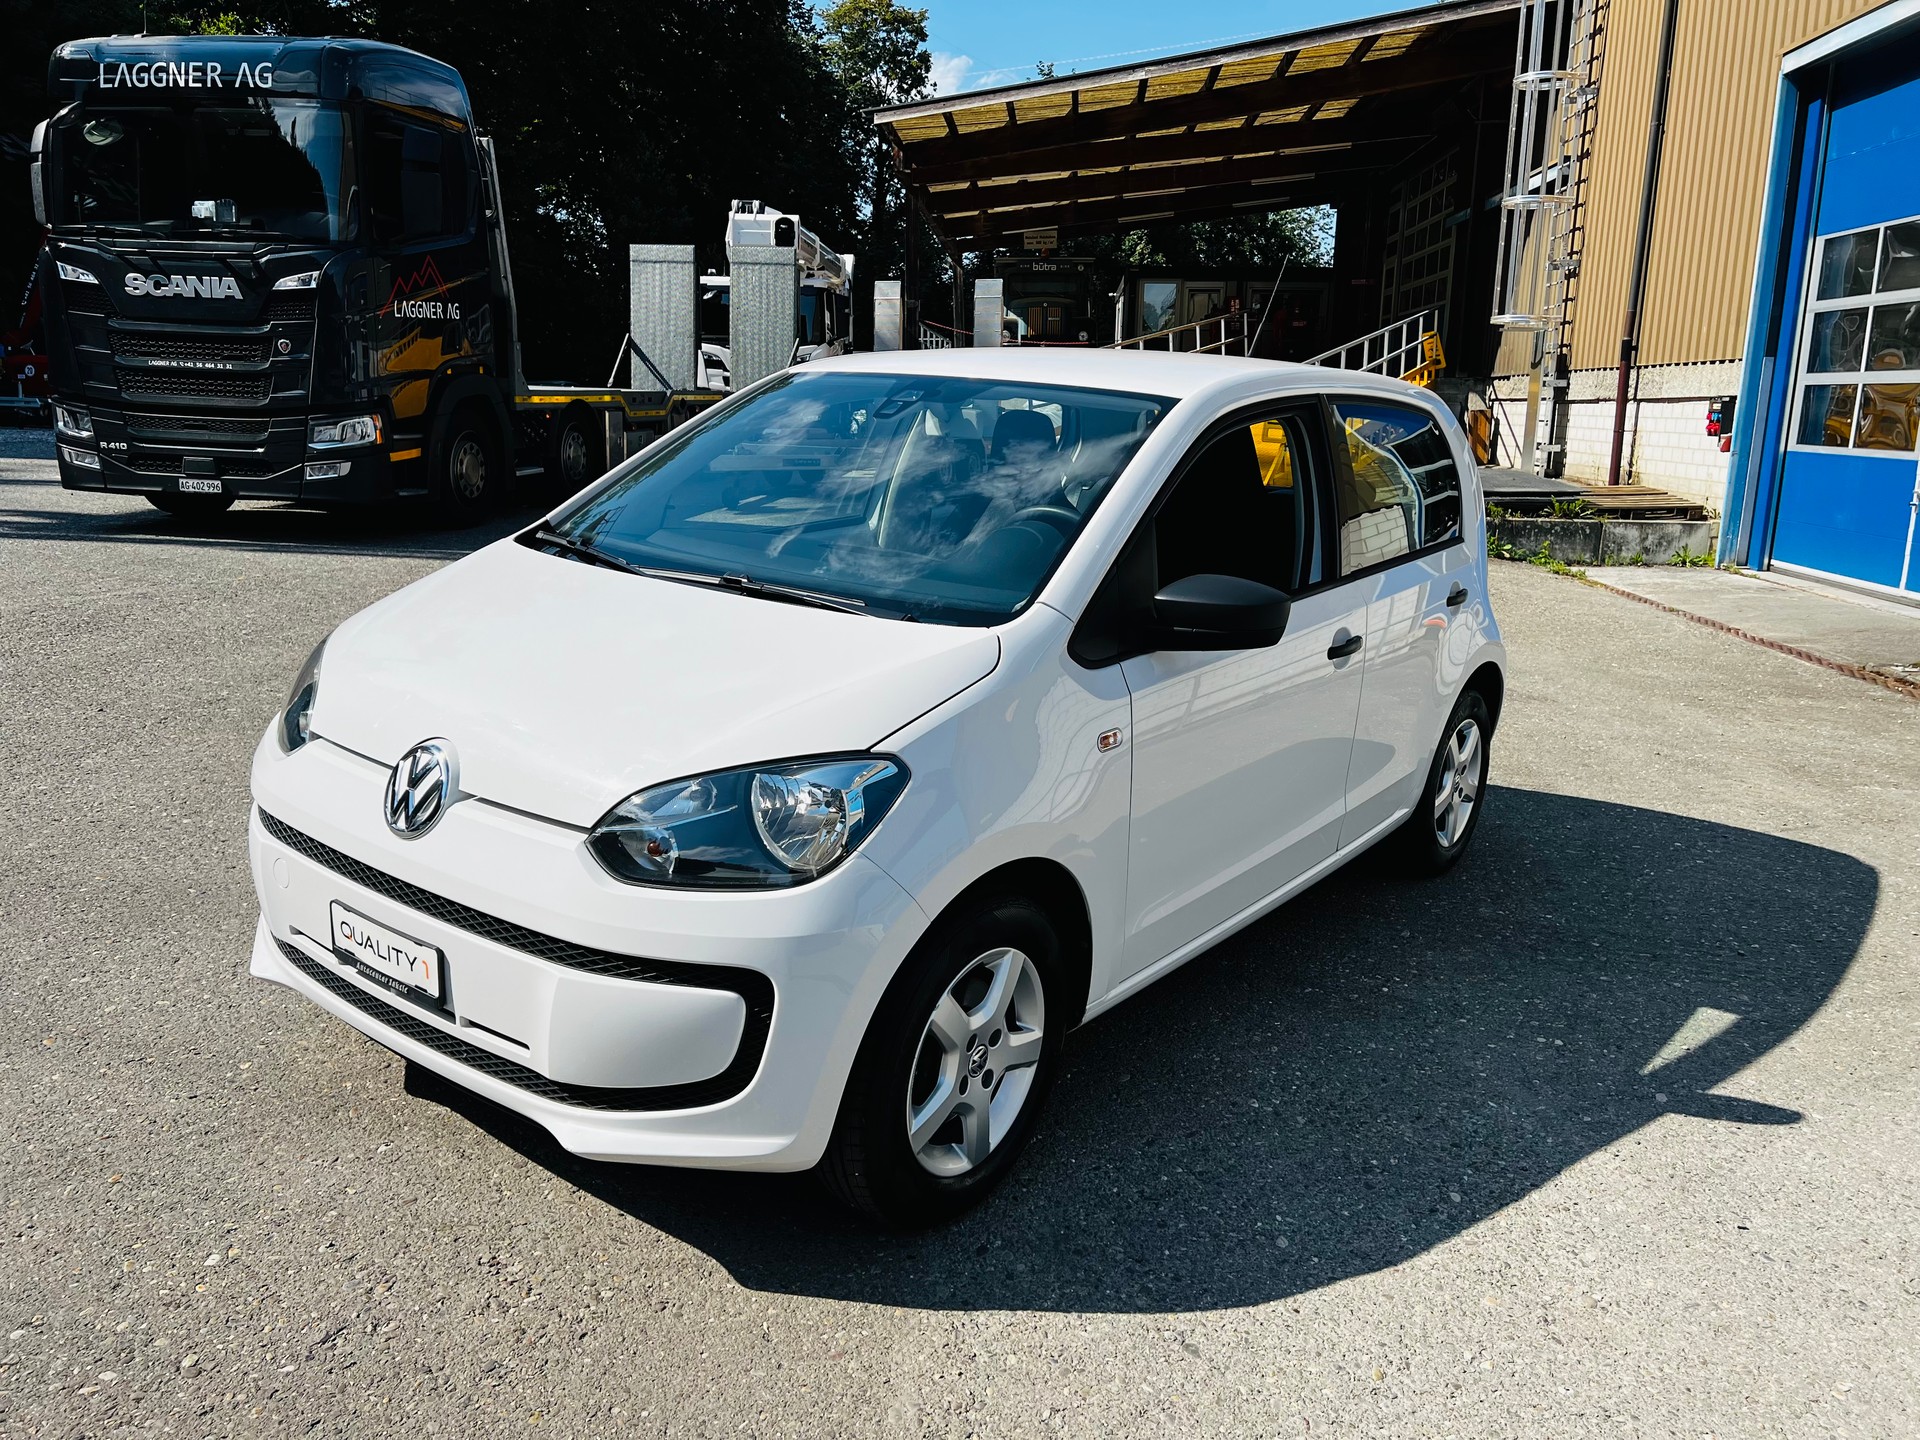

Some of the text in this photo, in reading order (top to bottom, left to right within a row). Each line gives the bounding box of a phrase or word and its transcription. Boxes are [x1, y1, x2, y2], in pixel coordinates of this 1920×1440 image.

[100, 62, 273, 88] LAGGNER AG
[124, 272, 244, 300] SCANIA
[394, 300, 460, 320] LAGGNER AG
[100, 441, 128, 450] R 410
[340, 920, 430, 980] QUALITY 1
